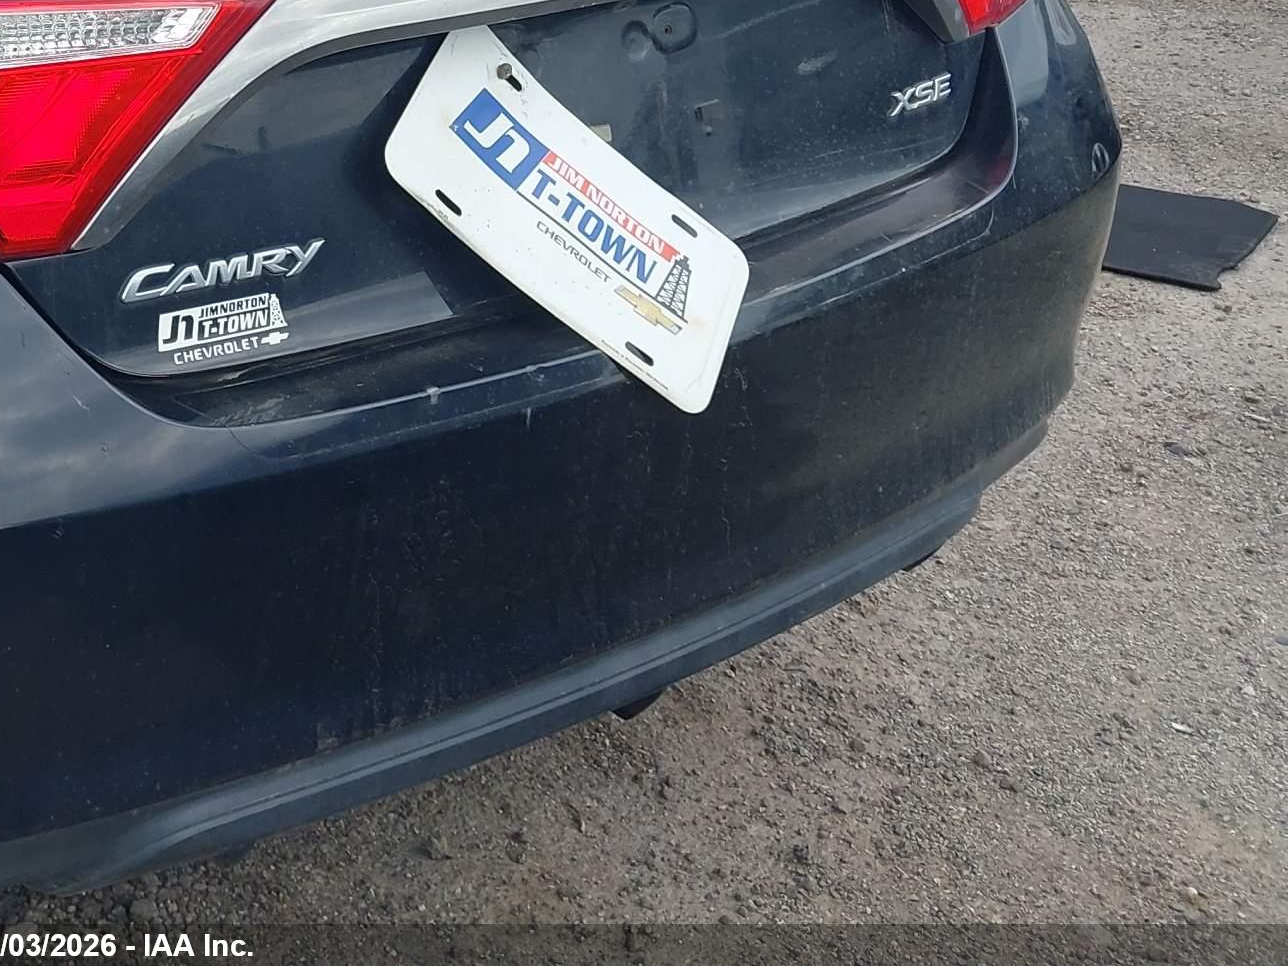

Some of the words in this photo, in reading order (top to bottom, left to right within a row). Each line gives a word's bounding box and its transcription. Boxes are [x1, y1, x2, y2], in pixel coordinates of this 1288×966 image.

[888, 72, 952, 117] XSE
[531, 168, 658, 284] T-TOWN
[544, 154, 587, 195] JIM
[587, 182, 665, 258] NORTON
[120, 238, 326, 303] CAMRY
[536, 220, 612, 283] CHEVROLET
[173, 336, 260, 365] CHEVROLET
[201, 308, 269, 339] T-TOWN
